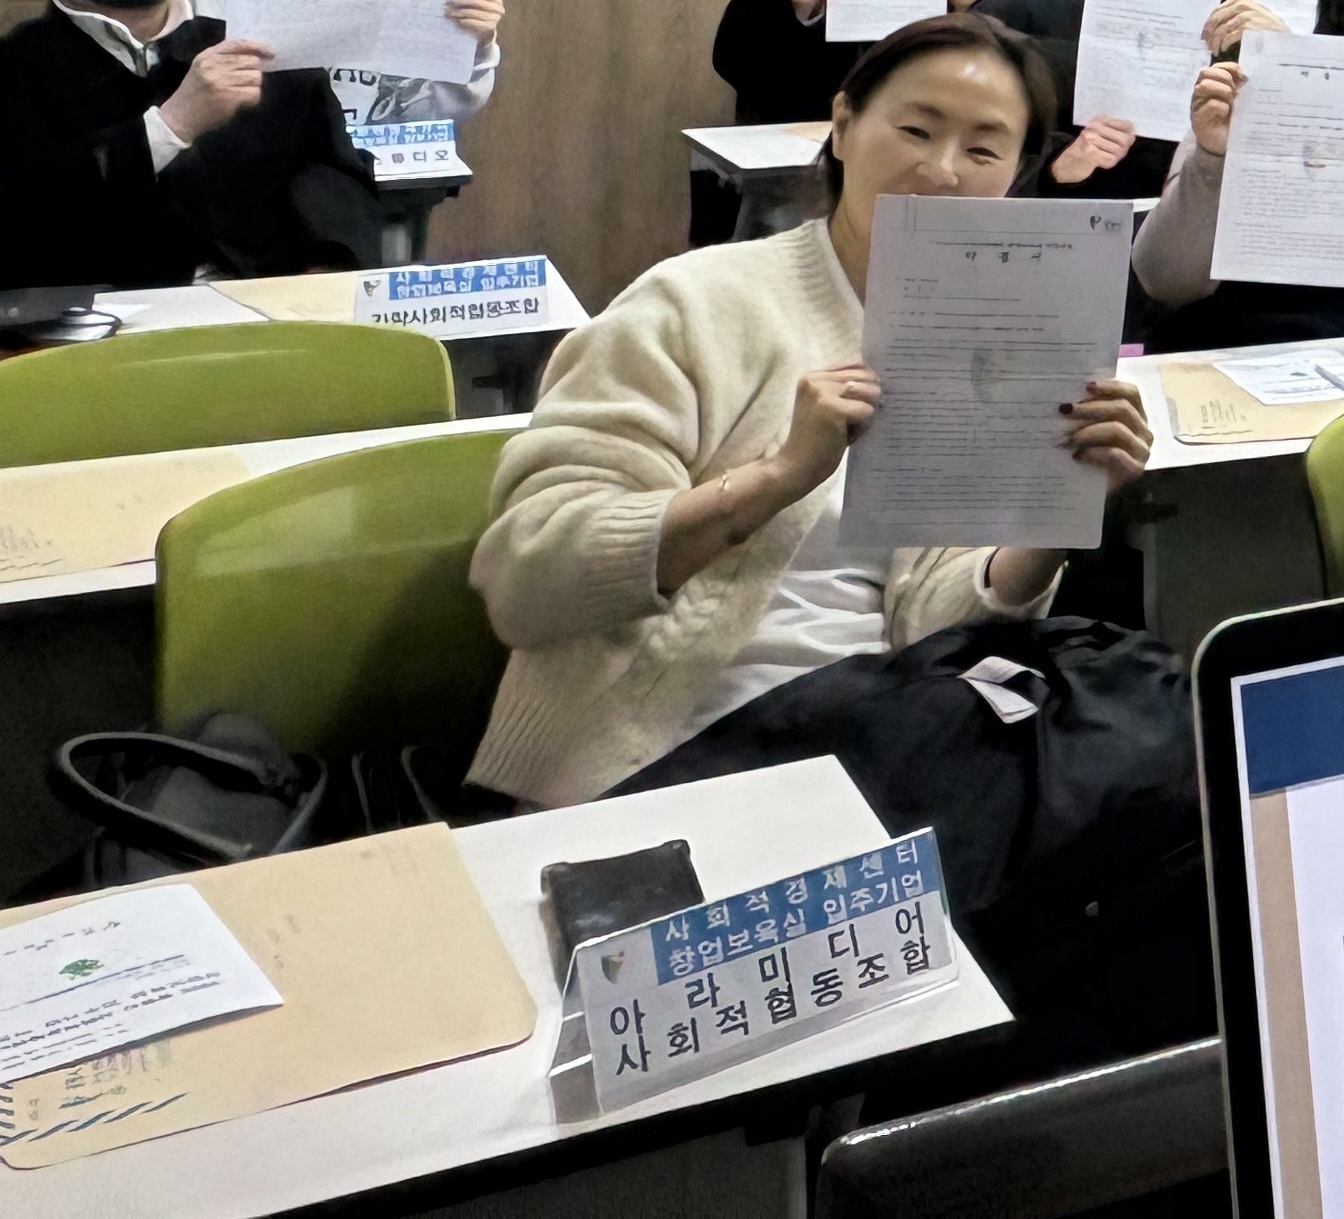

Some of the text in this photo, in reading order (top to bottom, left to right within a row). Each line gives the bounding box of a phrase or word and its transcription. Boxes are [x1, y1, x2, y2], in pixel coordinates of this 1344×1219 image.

[669, 869, 924, 976] 창업보육실 입주기업
[615, 934, 931, 1076] 사회적협동조합
